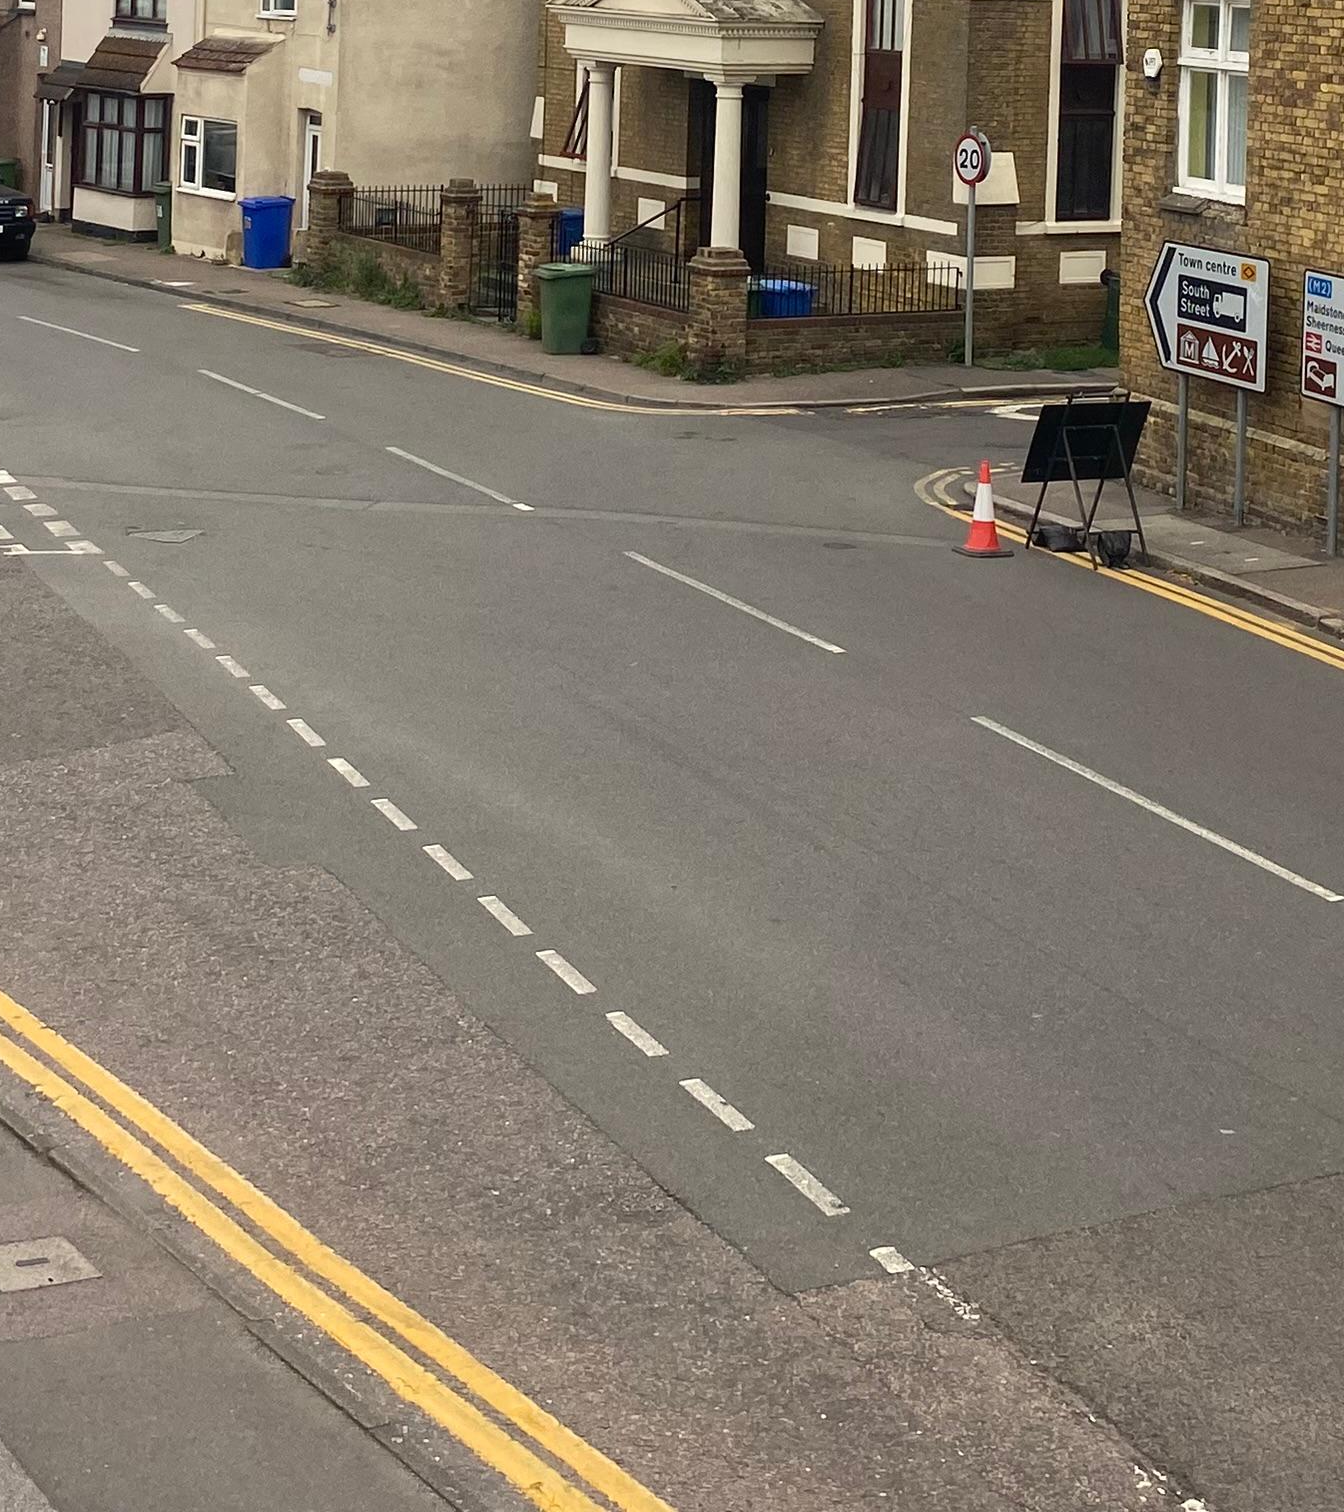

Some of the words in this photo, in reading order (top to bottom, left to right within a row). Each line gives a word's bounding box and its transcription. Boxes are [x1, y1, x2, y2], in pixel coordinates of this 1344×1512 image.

[959, 148, 980, 169] 20
[1178, 252, 1203, 270] Town
[1205, 261, 1237, 276] centre
[1182, 280, 1210, 299] South
[1309, 278, 1332, 297] (M2)
[1180, 298, 1210, 317] Street
